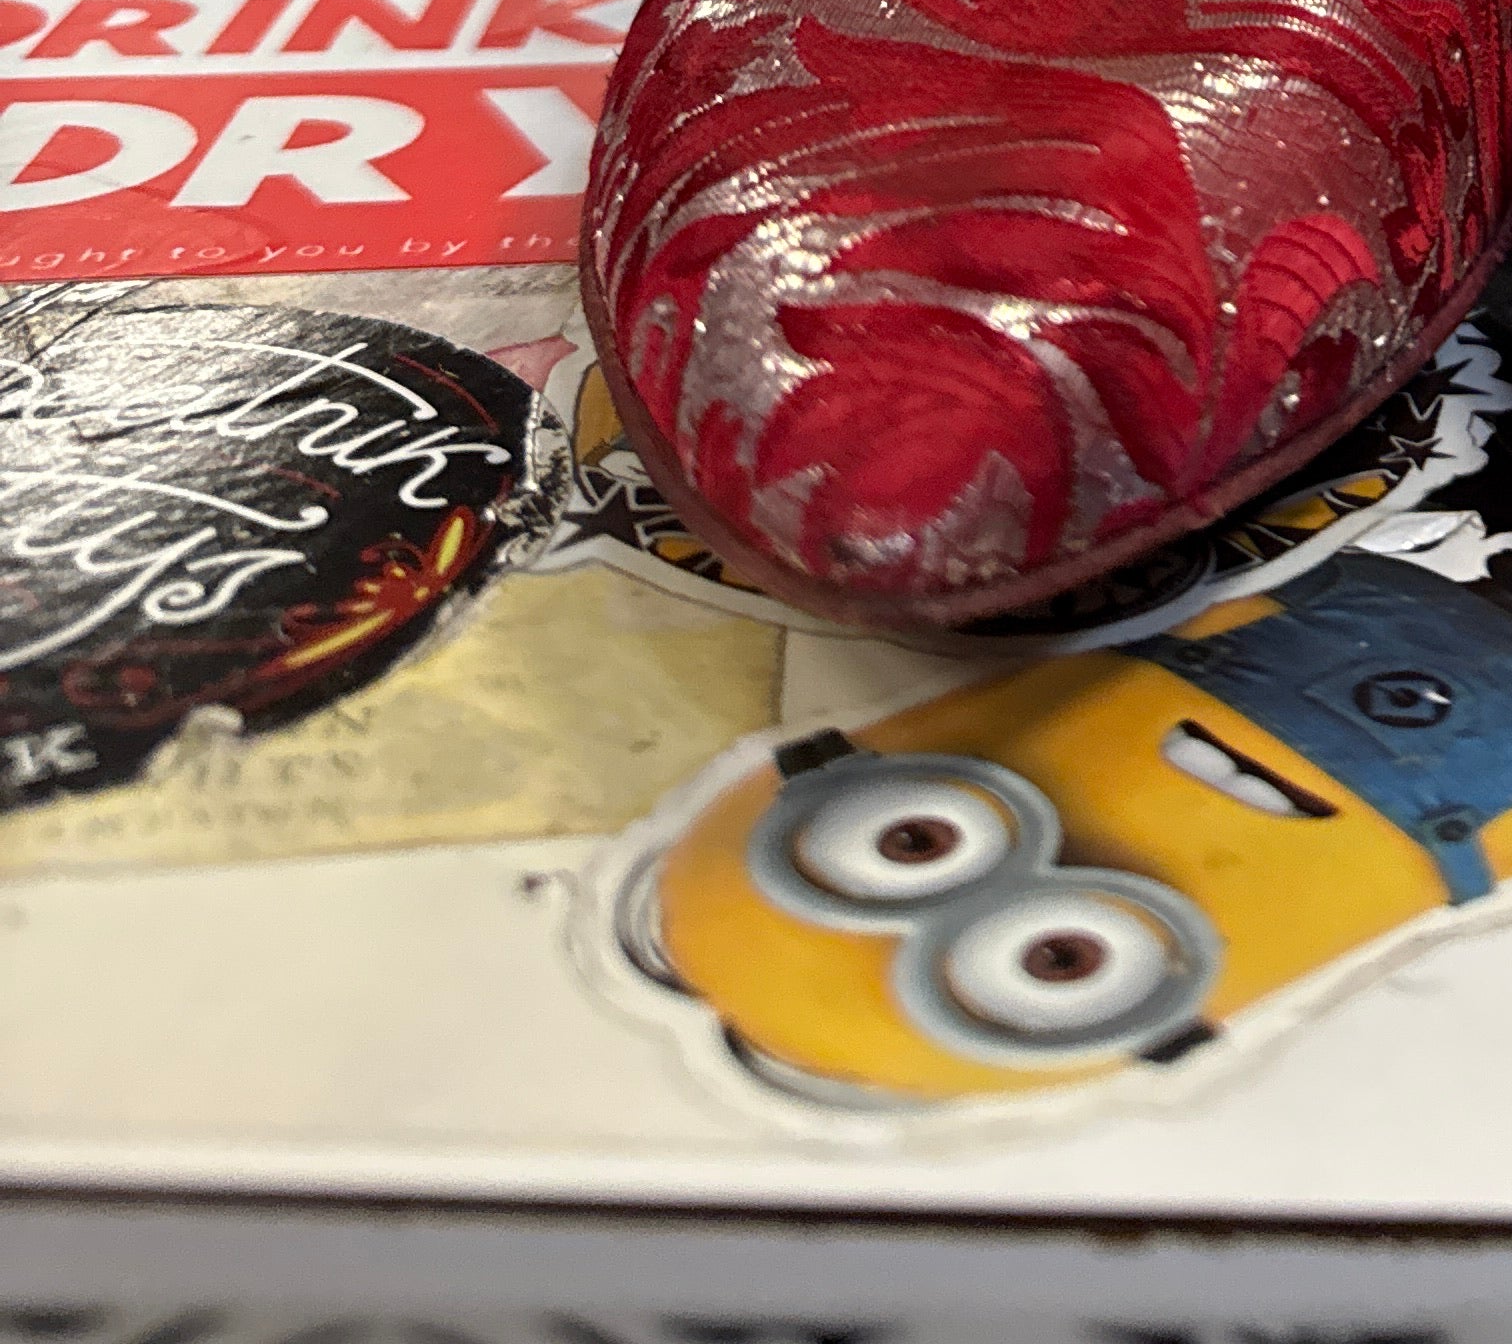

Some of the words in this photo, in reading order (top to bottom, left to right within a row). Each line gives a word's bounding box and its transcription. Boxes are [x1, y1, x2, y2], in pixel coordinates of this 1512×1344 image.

[170, 246, 226, 260] to
[258, 243, 364, 263] you
[403, 237, 468, 256] by
